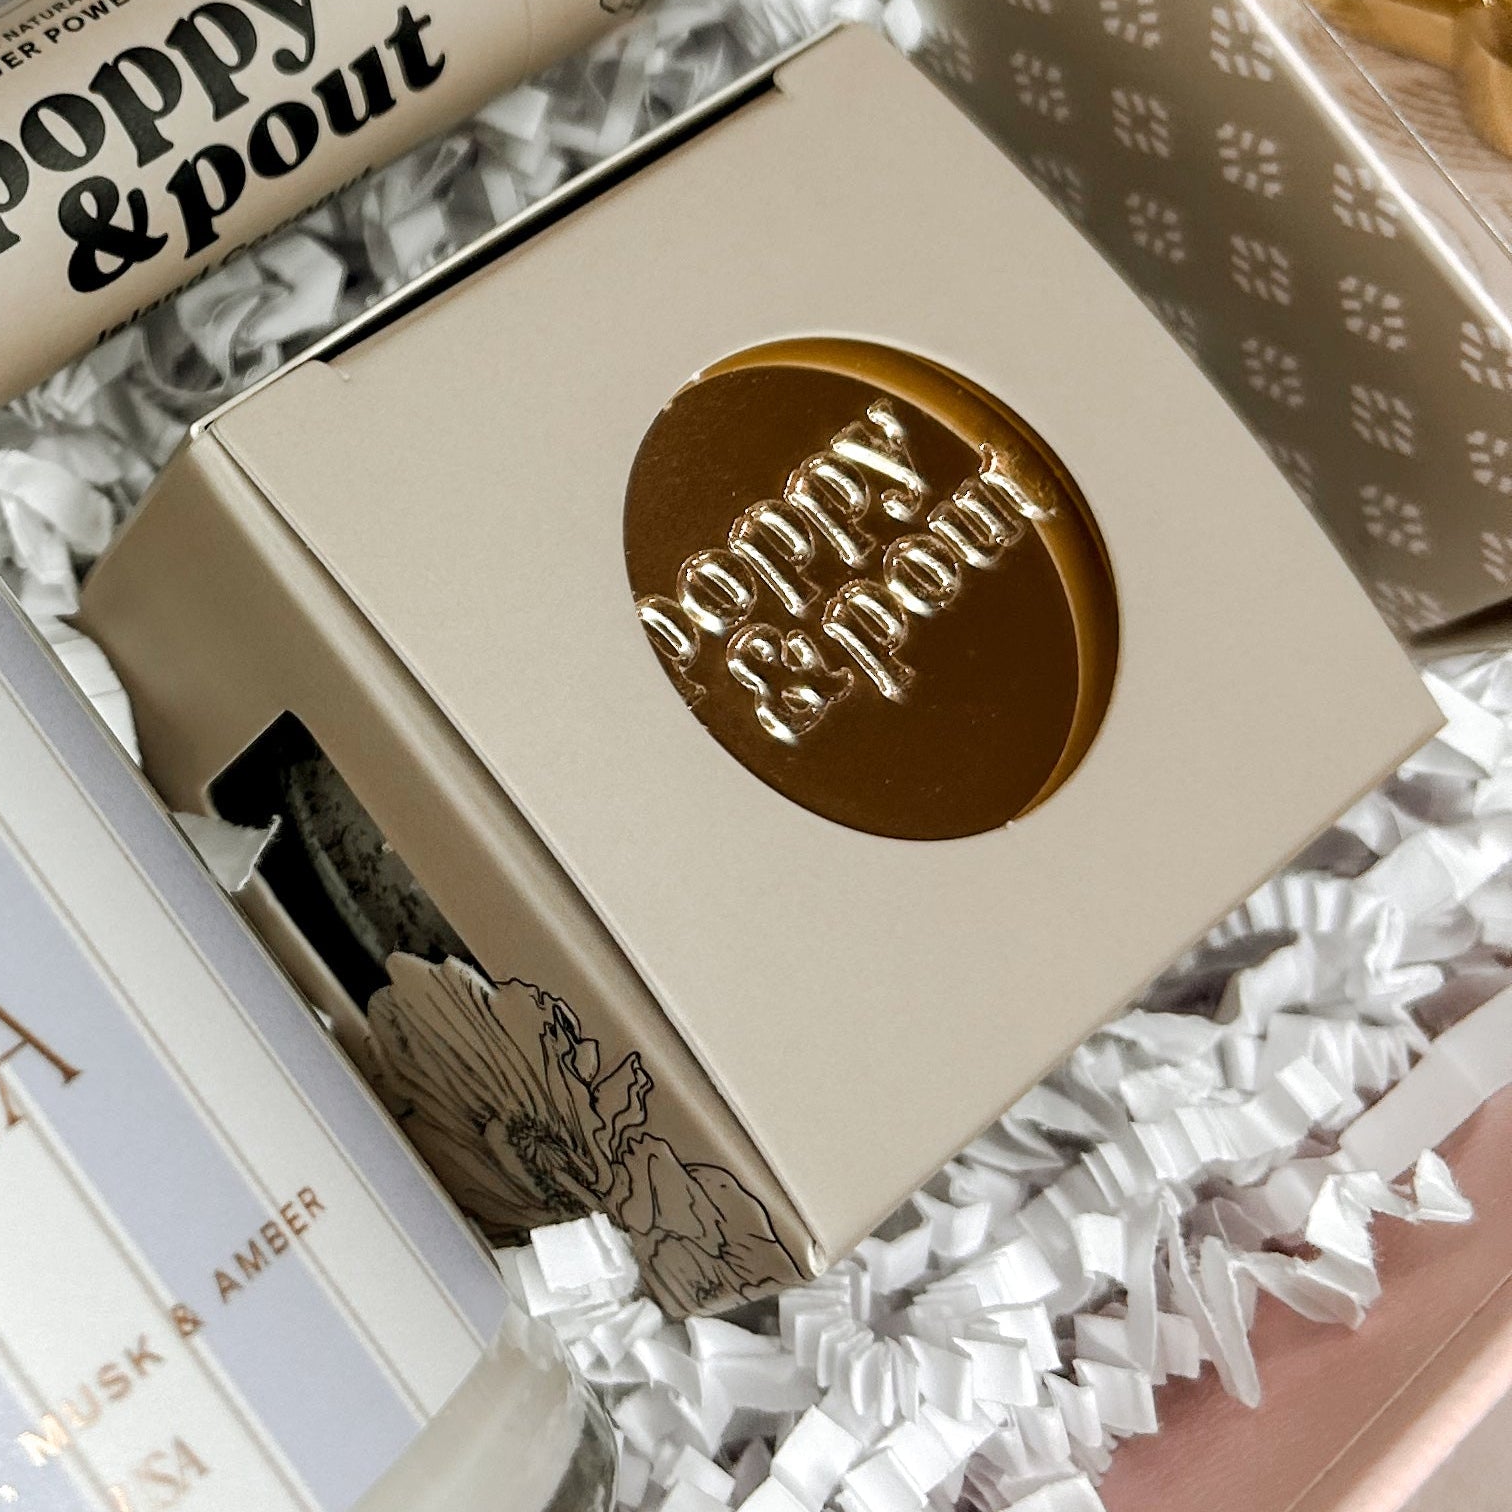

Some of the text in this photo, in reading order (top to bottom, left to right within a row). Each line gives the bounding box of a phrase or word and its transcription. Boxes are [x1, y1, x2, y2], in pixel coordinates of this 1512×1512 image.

[18, 1186, 327, 1467] MUSK & AMBER
